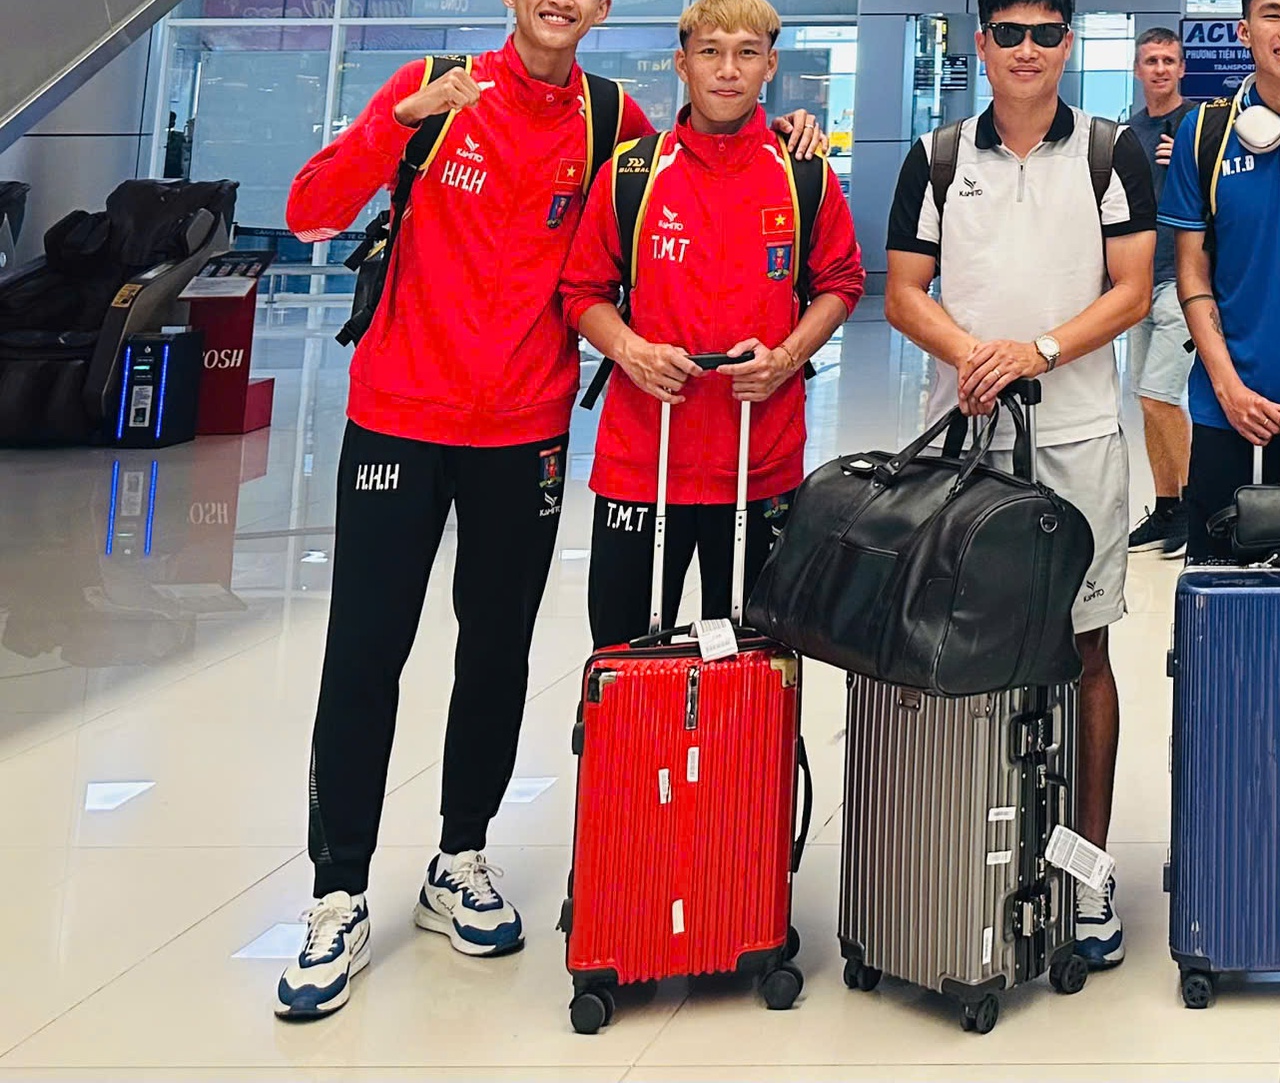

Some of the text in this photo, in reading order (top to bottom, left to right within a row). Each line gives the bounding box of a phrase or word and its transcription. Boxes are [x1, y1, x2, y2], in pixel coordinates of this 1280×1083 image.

[441, 160, 487, 194] H.H.H
[651, 235, 690, 262] T.M.T
[203, 349, 244, 369] OSH
[356, 463, 400, 490] H.H.H
[607, 502, 648, 532] T.M.T
